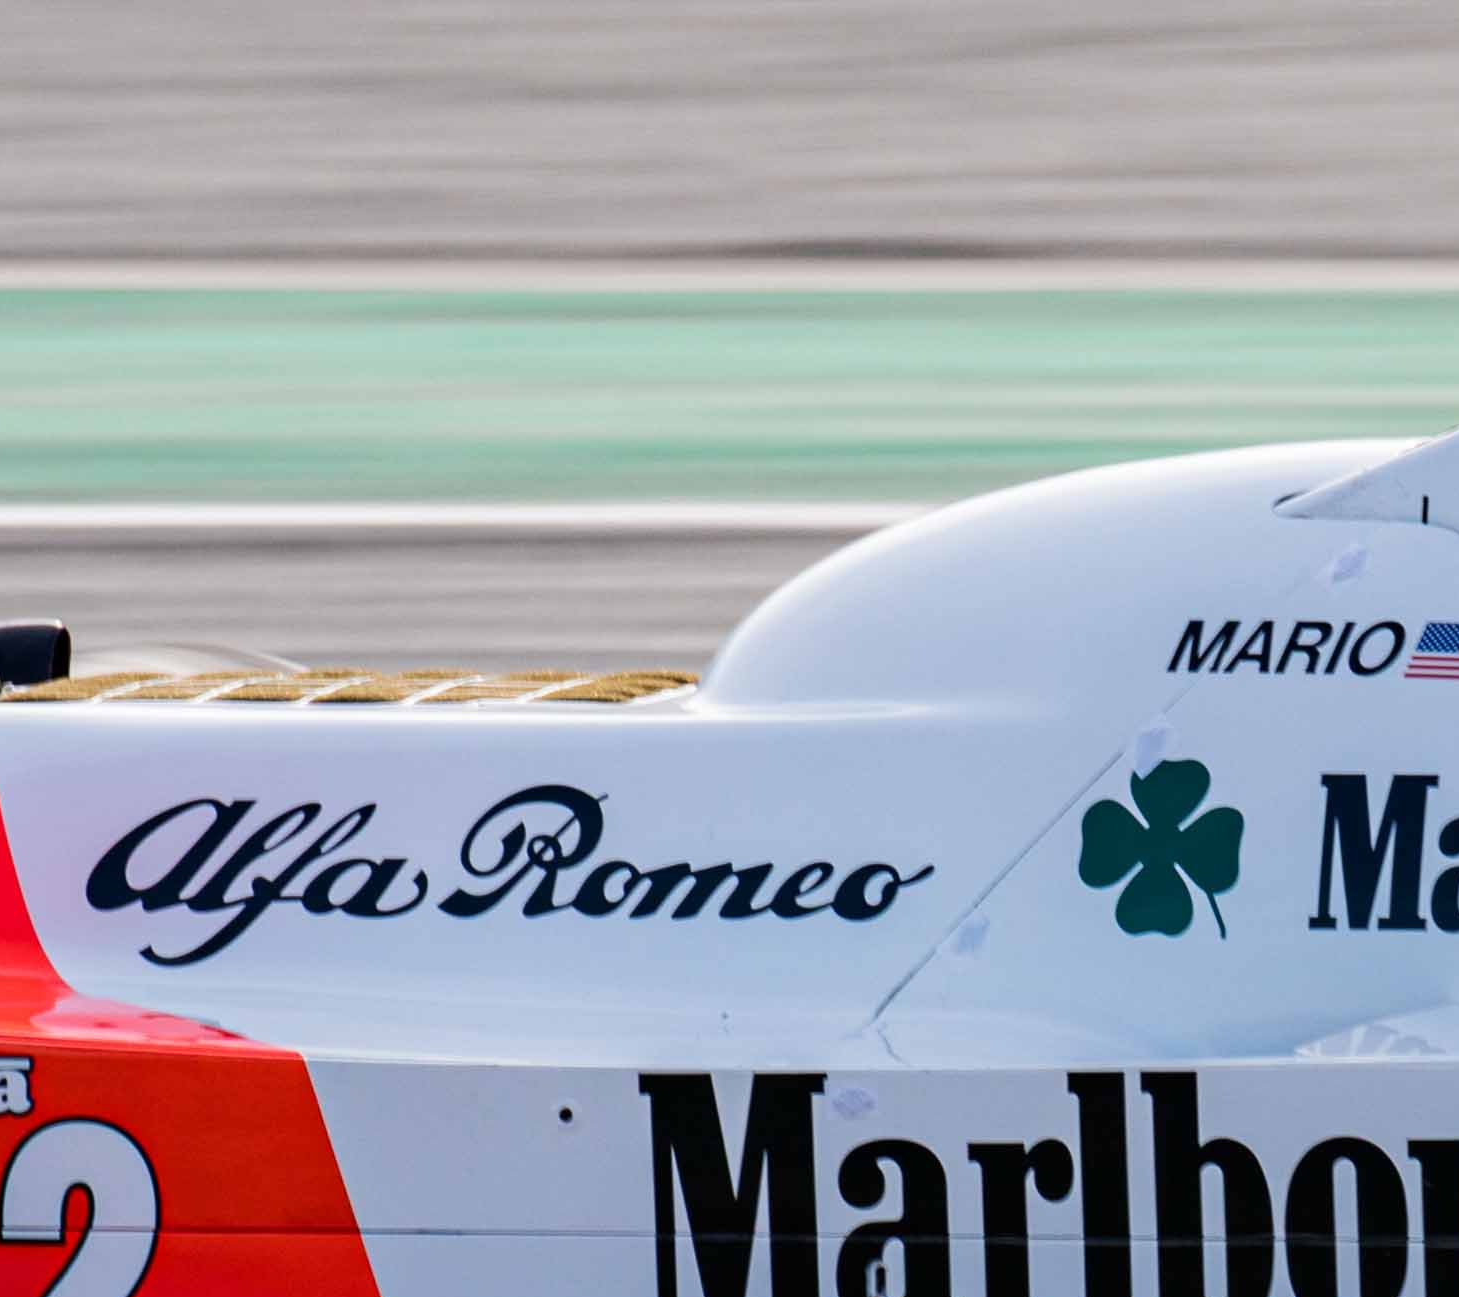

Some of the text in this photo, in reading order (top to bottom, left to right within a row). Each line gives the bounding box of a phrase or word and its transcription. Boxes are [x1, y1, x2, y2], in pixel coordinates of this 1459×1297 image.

[1167, 619, 1406, 678] MARIO
[85, 783, 936, 967] Alfa Romeo
